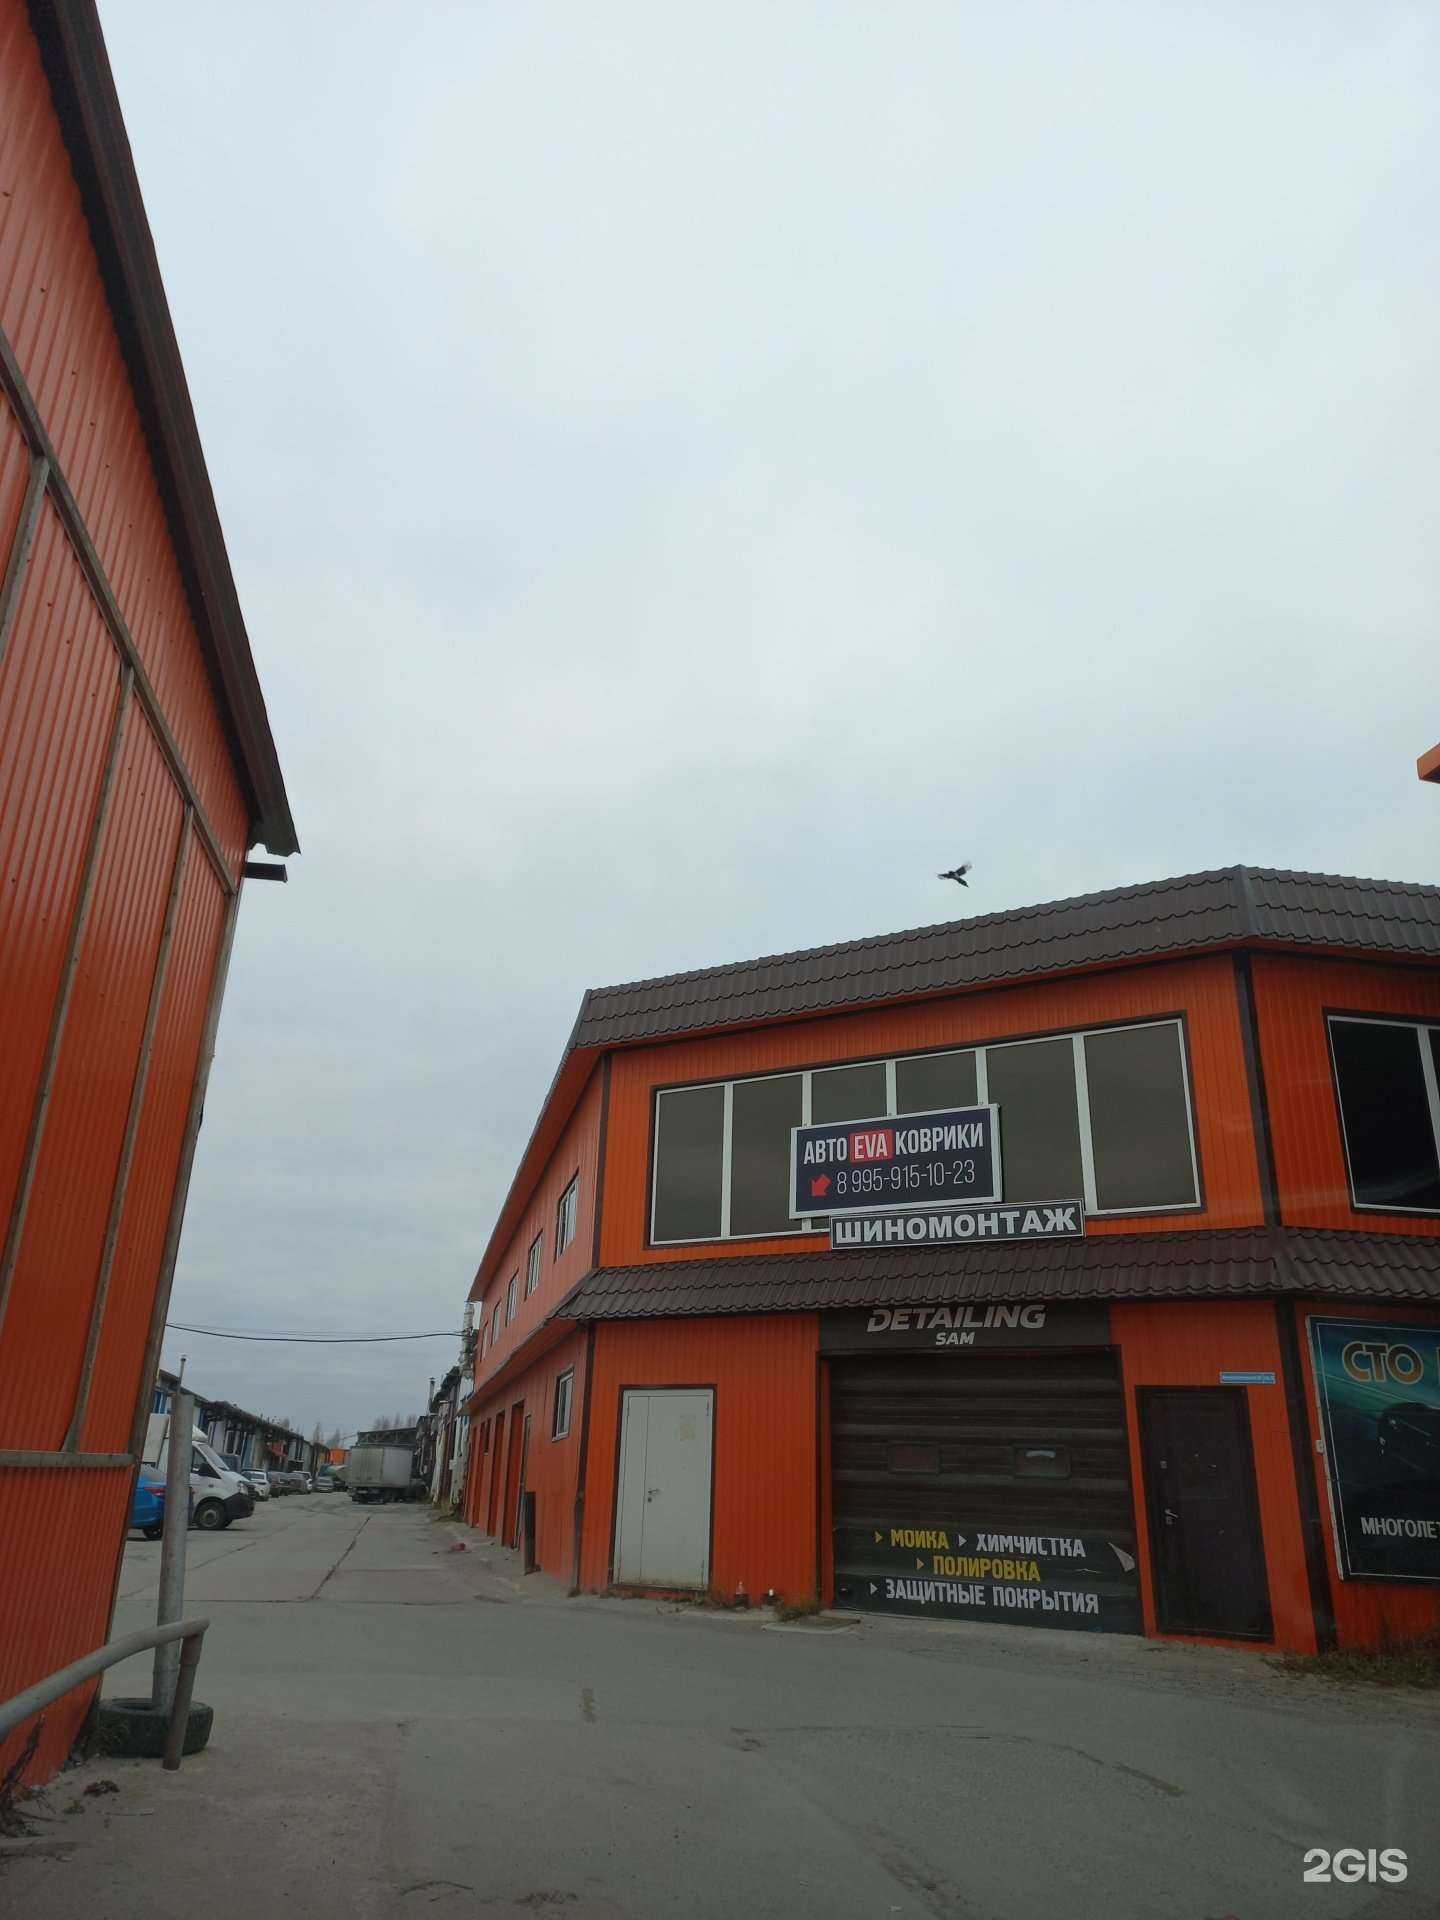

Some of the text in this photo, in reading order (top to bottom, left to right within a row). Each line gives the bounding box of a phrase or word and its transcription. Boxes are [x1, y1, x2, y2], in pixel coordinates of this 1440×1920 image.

[803, 1122, 984, 1165] АВТО EVA КОВРИКИ
[836, 1159, 976, 1195] 8 995-915-10-23
[835, 1207, 1076, 1243] ШИНОМОНТАЖ
[867, 1304, 1046, 1332] DETAILING
[935, 1331, 976, 1346] SAM
[1341, 1341, 1424, 1385] СТО
[976, 1533, 1086, 1558] ХИМЧИСТКА
[933, 1555, 1041, 1582] ПОЛИРОВКА
[885, 1578, 1099, 1614] ЗАЩИТНЫЕ ПОКРЫТИЯ
